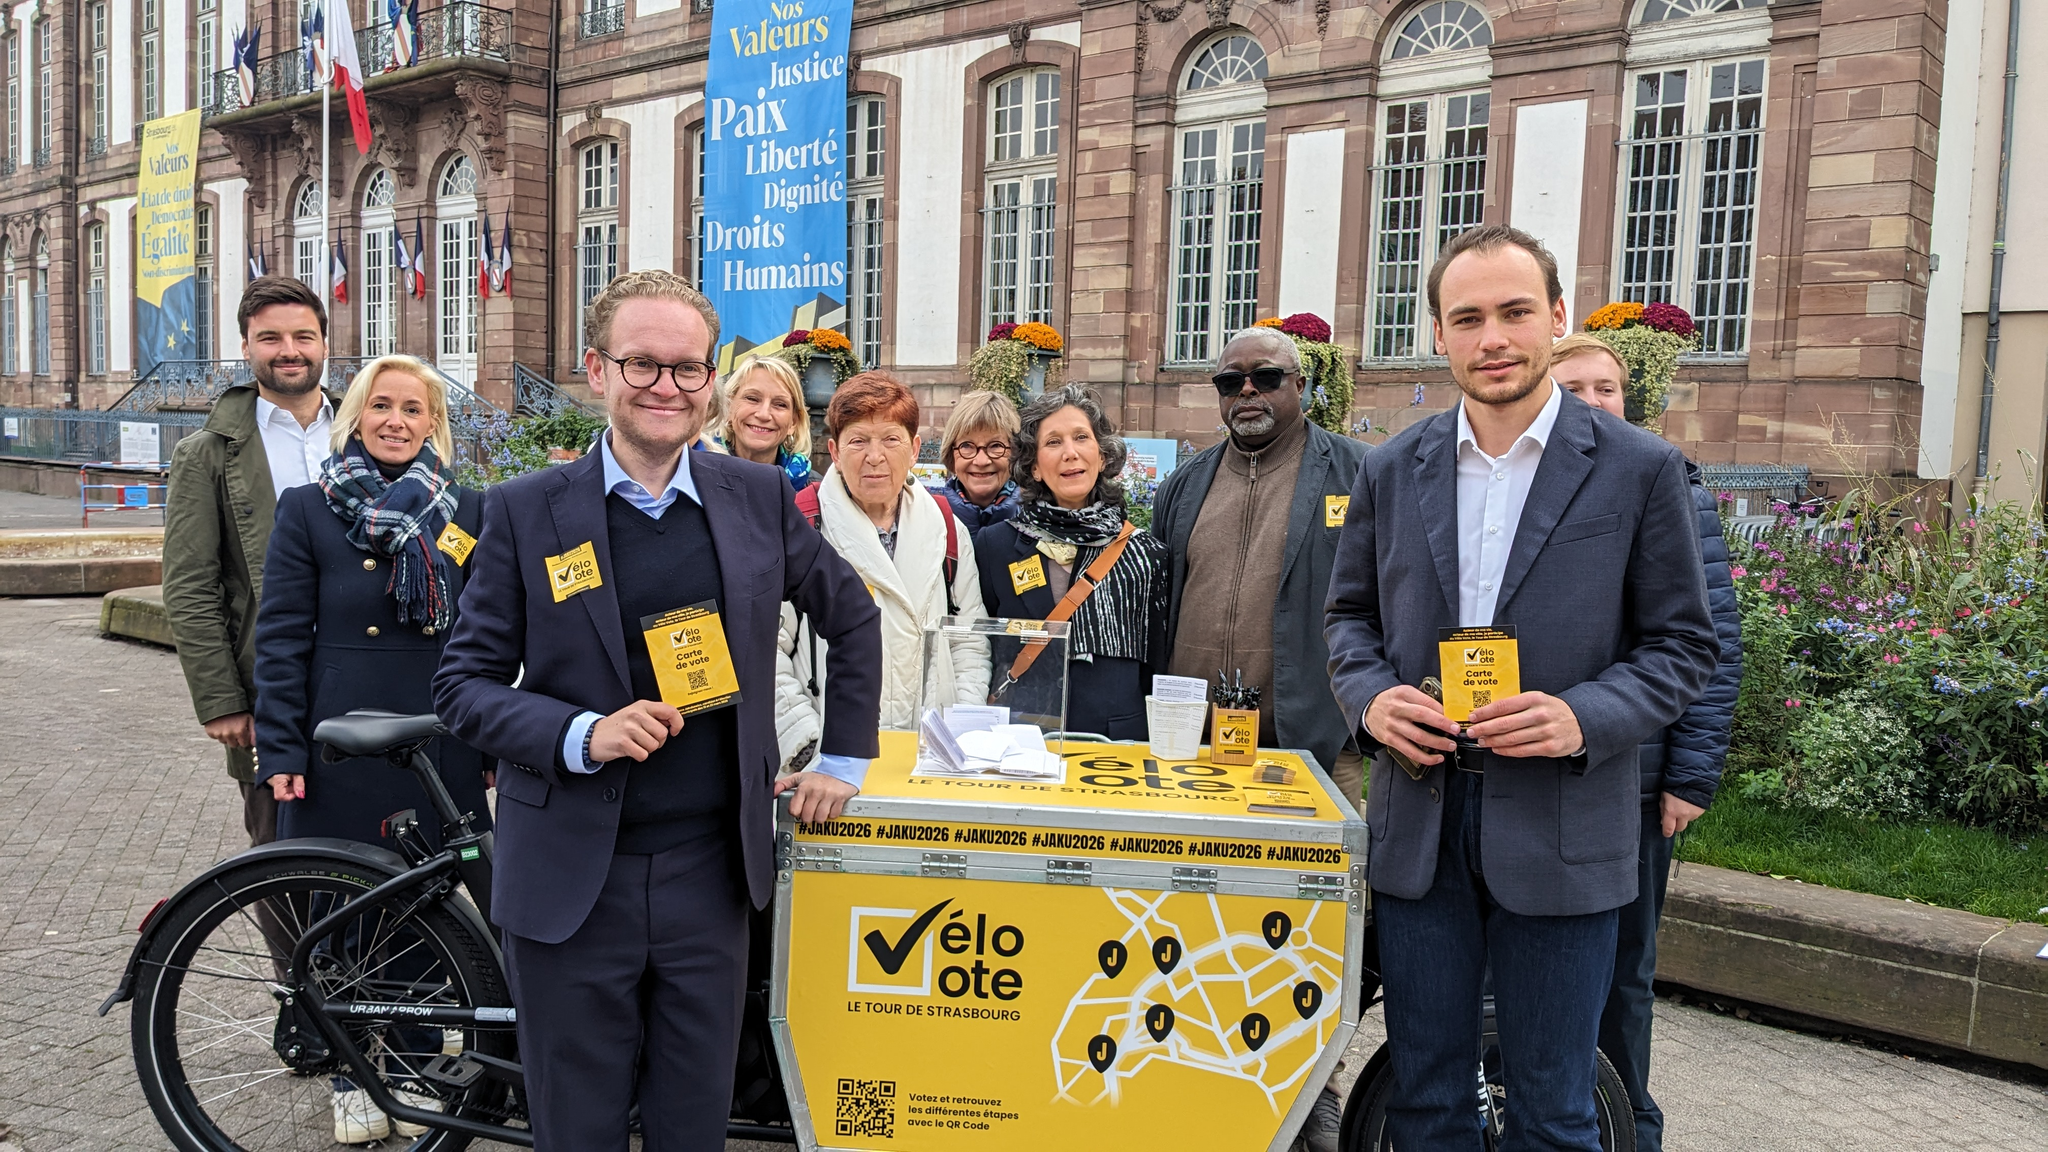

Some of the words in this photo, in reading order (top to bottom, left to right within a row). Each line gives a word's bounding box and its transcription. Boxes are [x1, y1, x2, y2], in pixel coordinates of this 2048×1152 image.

[769, 0, 804, 24] Nos
[729, 15, 829, 58] Valeurs
[769, 50, 845, 90] Justice
[711, 86, 788, 141] Paix
[745, 128, 838, 175] Liberté
[148, 153, 189, 176] Valeurs
[160, 188, 172, 205] de
[764, 171, 844, 213] Dignité
[706, 214, 785, 252] Droits
[141, 223, 190, 266] Égalité
[723, 252, 845, 291] Humains
[675, 662, 688, 670] de
[688, 656, 710, 667] vote
[676, 649, 703, 661] Carte
[1463, 678, 1475, 686] de
[1477, 678, 1498, 686] vote
[1466, 670, 1493, 678] Carte
[908, 778, 926, 786] LE
[941, 780, 1012, 790] TOUR
[1020, 784, 1053, 792] DE
[1060, 786, 1240, 803] STRASBOURG
[798, 821, 872, 838] #JAKU2026
[876, 824, 950, 842] #JAKU2026
[954, 828, 1028, 846] #JAKU2026
[1032, 832, 1105, 850] #JAKU2026
[1109, 837, 1184, 855] #JAKU2026
[1188, 841, 1262, 860] #JAKU2026
[1266, 846, 1342, 864] #JAKU2026
[266, 869, 326, 880] SCHWALBE
[342, 874, 377, 889] PICK-U
[1271, 919, 1282, 938] J
[1107, 948, 1117, 967] J
[1161, 944, 1172, 963] J
[1301, 989, 1313, 1008] J
[350, 1004, 389, 1014] URBAN
[847, 1000, 861, 1012] LE
[865, 1002, 902, 1015] TOUR
[906, 1004, 923, 1016] DE
[927, 1005, 1021, 1021] STRASBOURG
[1154, 1012, 1165, 1031] J
[1249, 1021, 1260, 1039] J
[1096, 1042, 1107, 1061] J
[909, 1093, 938, 1103] Votez
[939, 1094, 951, 1104] et
[952, 1096, 1002, 1106] retrouvez
[908, 1105, 923, 1114] les
[925, 1106, 981, 1118] différentes
[983, 1110, 1019, 1122] étapes
[907, 1119, 933, 1128] avec
[935, 1119, 944, 1128] le
[946, 1120, 961, 1130] QR
[963, 1121, 990, 1130] Code
